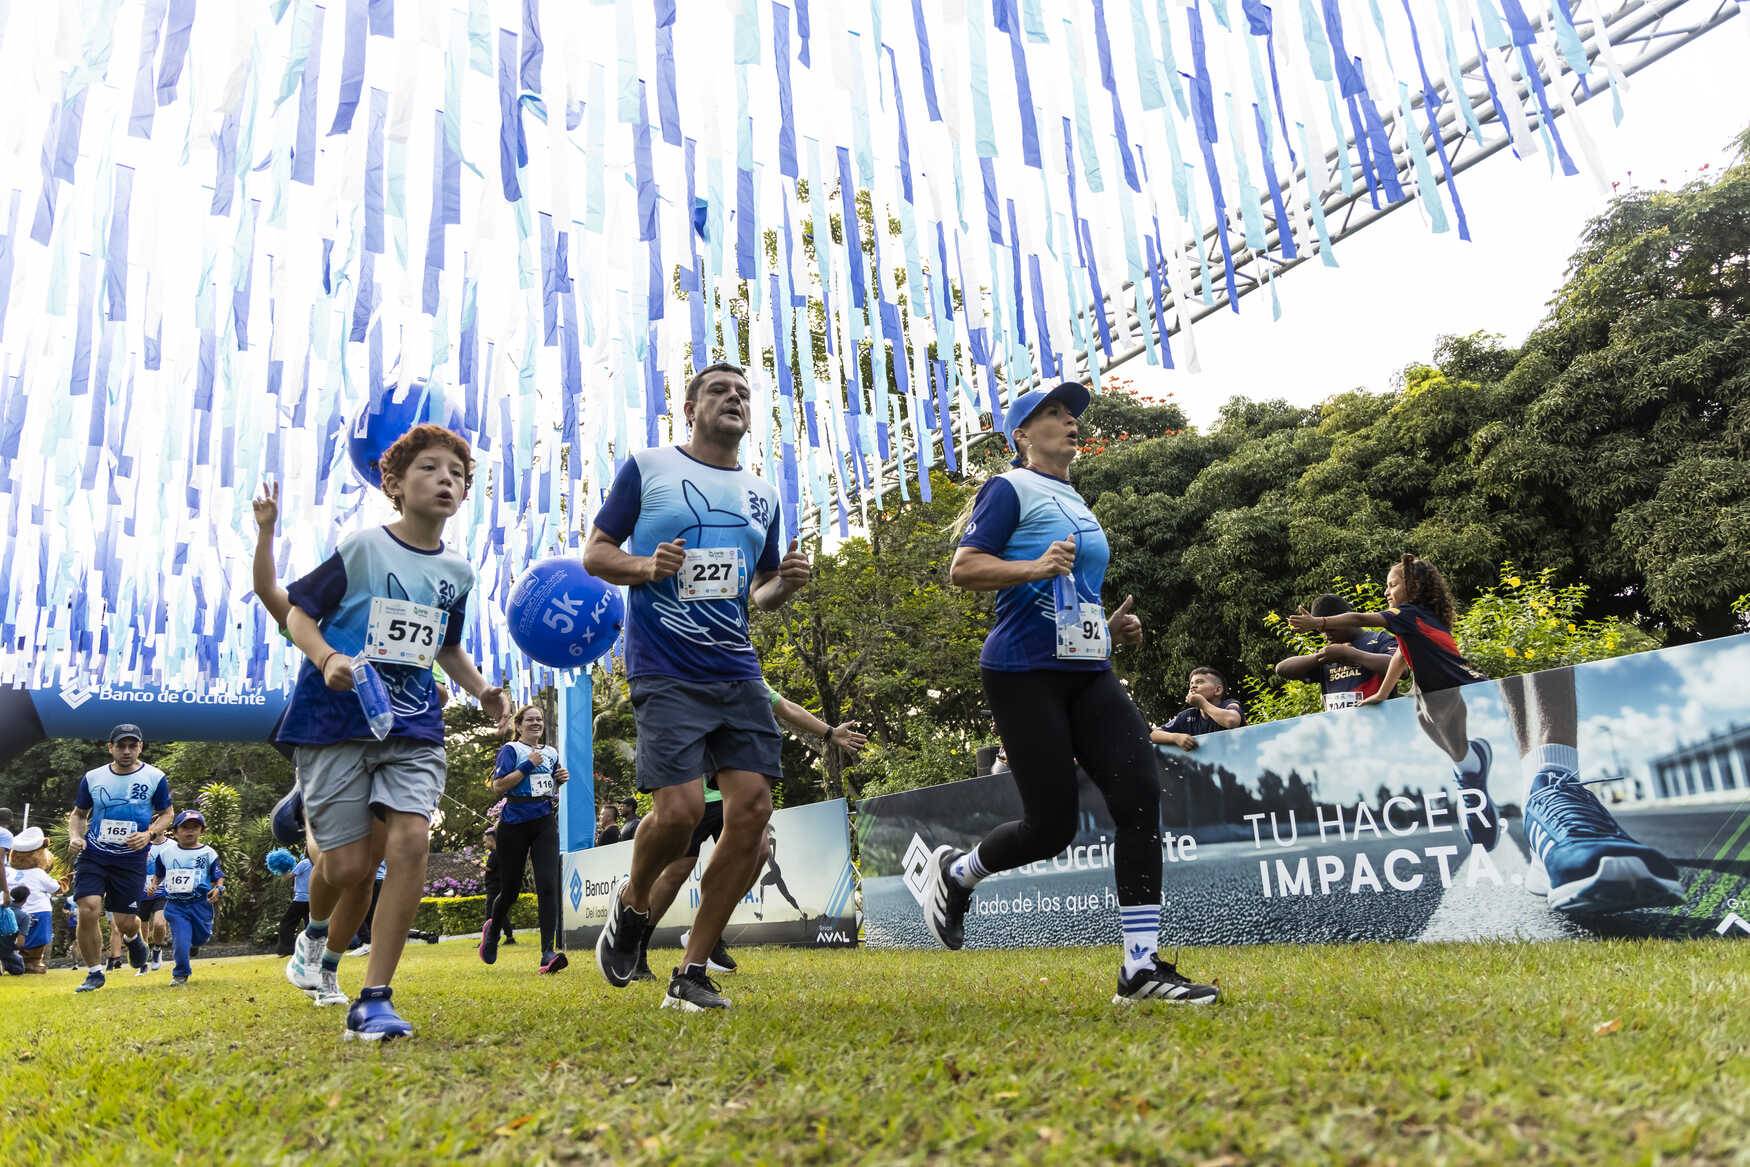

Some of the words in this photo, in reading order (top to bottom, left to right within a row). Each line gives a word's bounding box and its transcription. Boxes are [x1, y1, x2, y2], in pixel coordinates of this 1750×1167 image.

[692, 563, 733, 583] 227
[439, 579, 455, 599] 20
[387, 619, 434, 646] 573
[1082, 620, 1101, 640] 92
[1329, 669, 1362, 681] SOCIAL
[99, 687, 154, 702] Banco
[157, 690, 179, 703] de
[182, 691, 266, 705] Occidente
[132, 783, 149, 792] 20
[537, 780, 553, 789] 116
[131, 791, 148, 801] 26
[1243, 809, 1299, 849] TU
[1316, 788, 1509, 844] HACER,
[107, 826, 127, 836] 165
[1259, 843, 1524, 898] IMPACTA.
[172, 876, 190, 885] 167
[585, 879, 610, 897] Banco
[975, 892, 1009, 915] lado
[1012, 891, 1033, 912] de
[1037, 887, 1061, 914] los
[1066, 894, 1099, 916] que
[816, 931, 850, 943] AVAL
